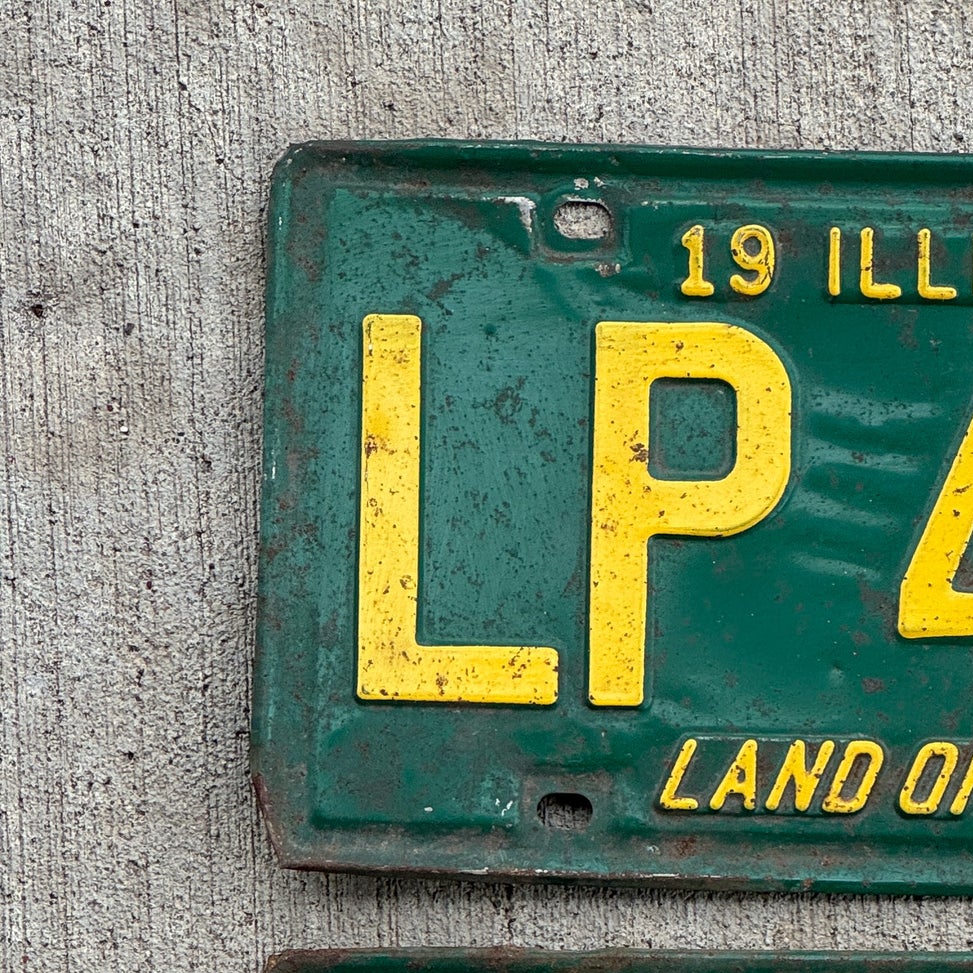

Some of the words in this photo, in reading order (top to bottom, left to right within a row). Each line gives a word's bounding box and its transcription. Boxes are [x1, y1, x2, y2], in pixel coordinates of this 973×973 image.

[680, 225, 777, 297] 19
[356, 313, 793, 709] LP
[658, 738, 886, 815] LAND
